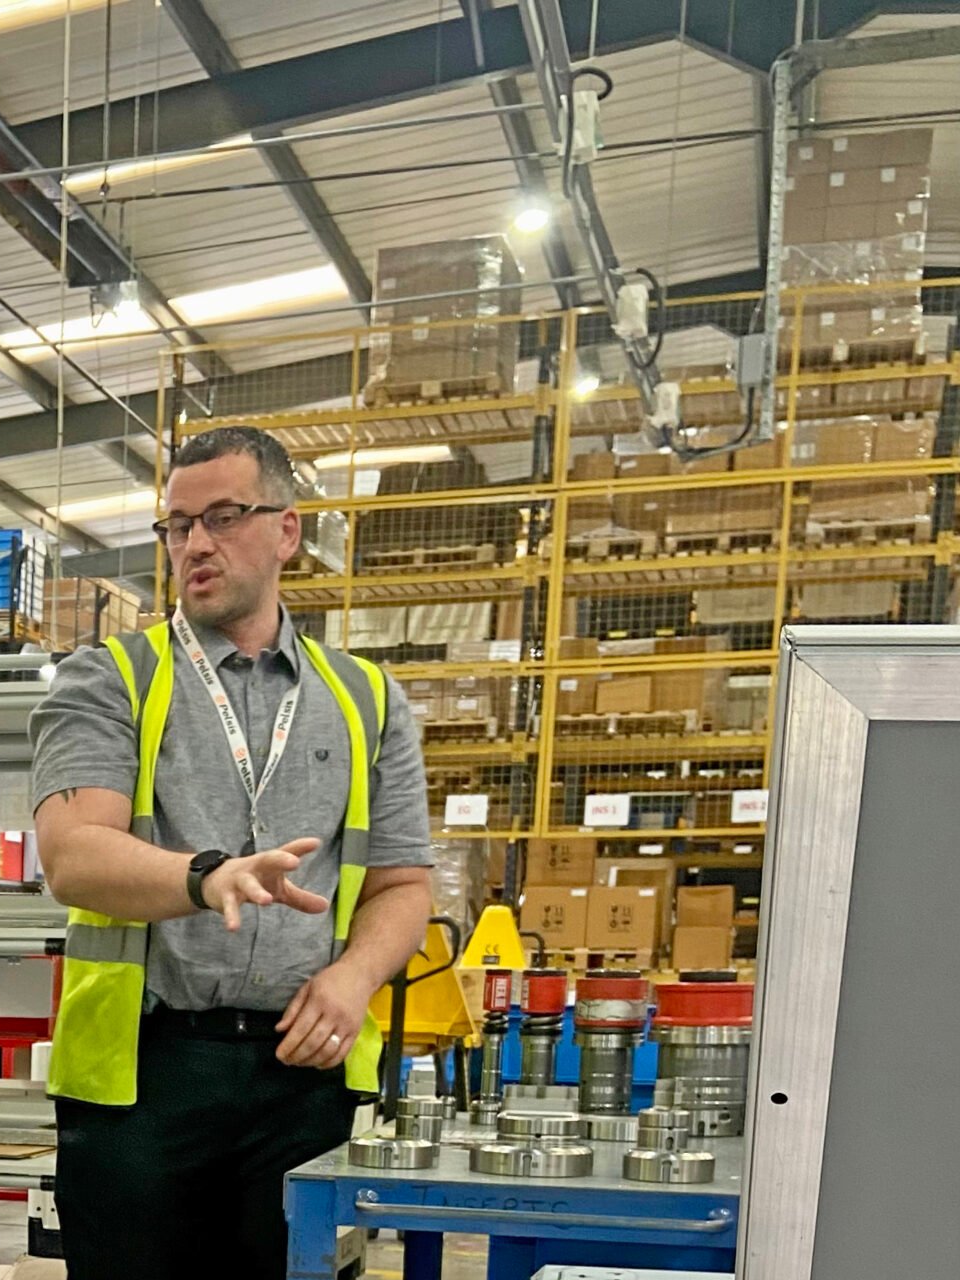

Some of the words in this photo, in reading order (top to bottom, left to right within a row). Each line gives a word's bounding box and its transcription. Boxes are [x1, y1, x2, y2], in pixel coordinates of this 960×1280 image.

[195, 658, 214, 685] Pelsis
[218, 704, 237, 735] Pelsis
[277, 700, 294, 731] Pelsis
[238, 758, 254, 794] Pelsis
